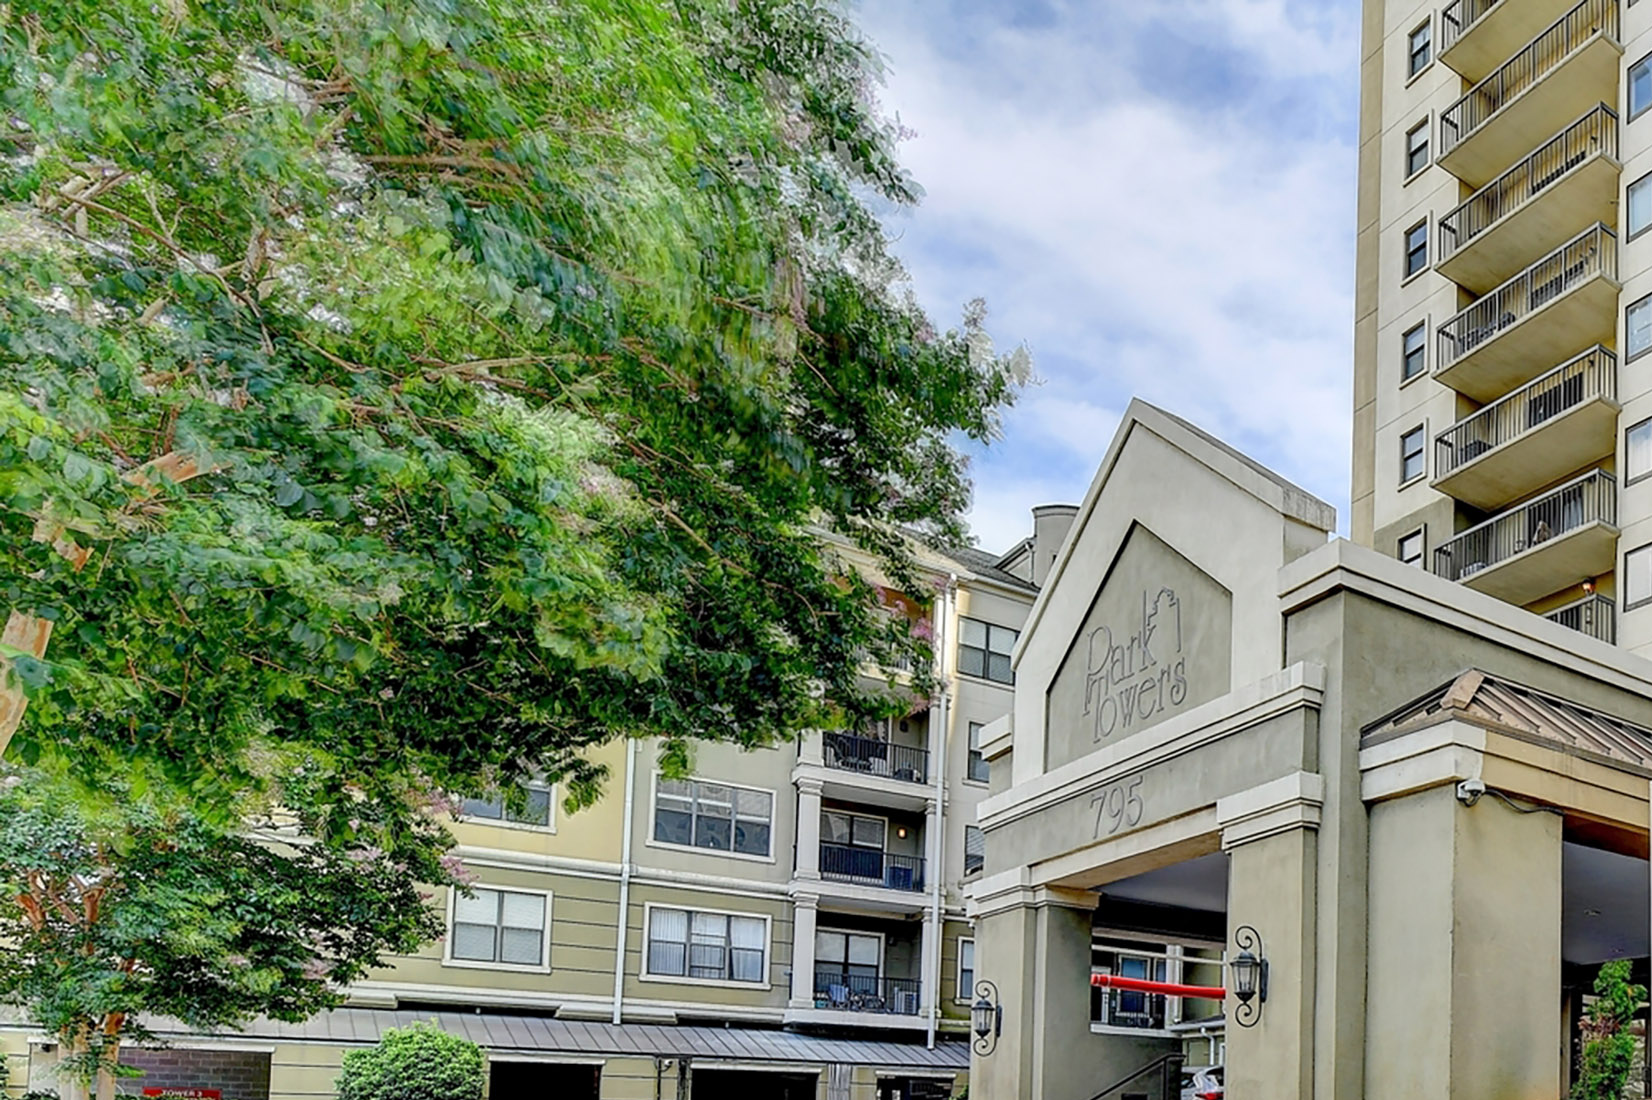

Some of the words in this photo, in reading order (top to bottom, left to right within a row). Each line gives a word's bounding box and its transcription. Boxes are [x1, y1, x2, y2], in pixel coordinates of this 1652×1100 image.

[1088, 590, 1157, 686] Park
[1083, 657, 1187, 744] Towers
[1090, 775, 1143, 839] 795
[161, 1089, 196, 1098] TOWER
